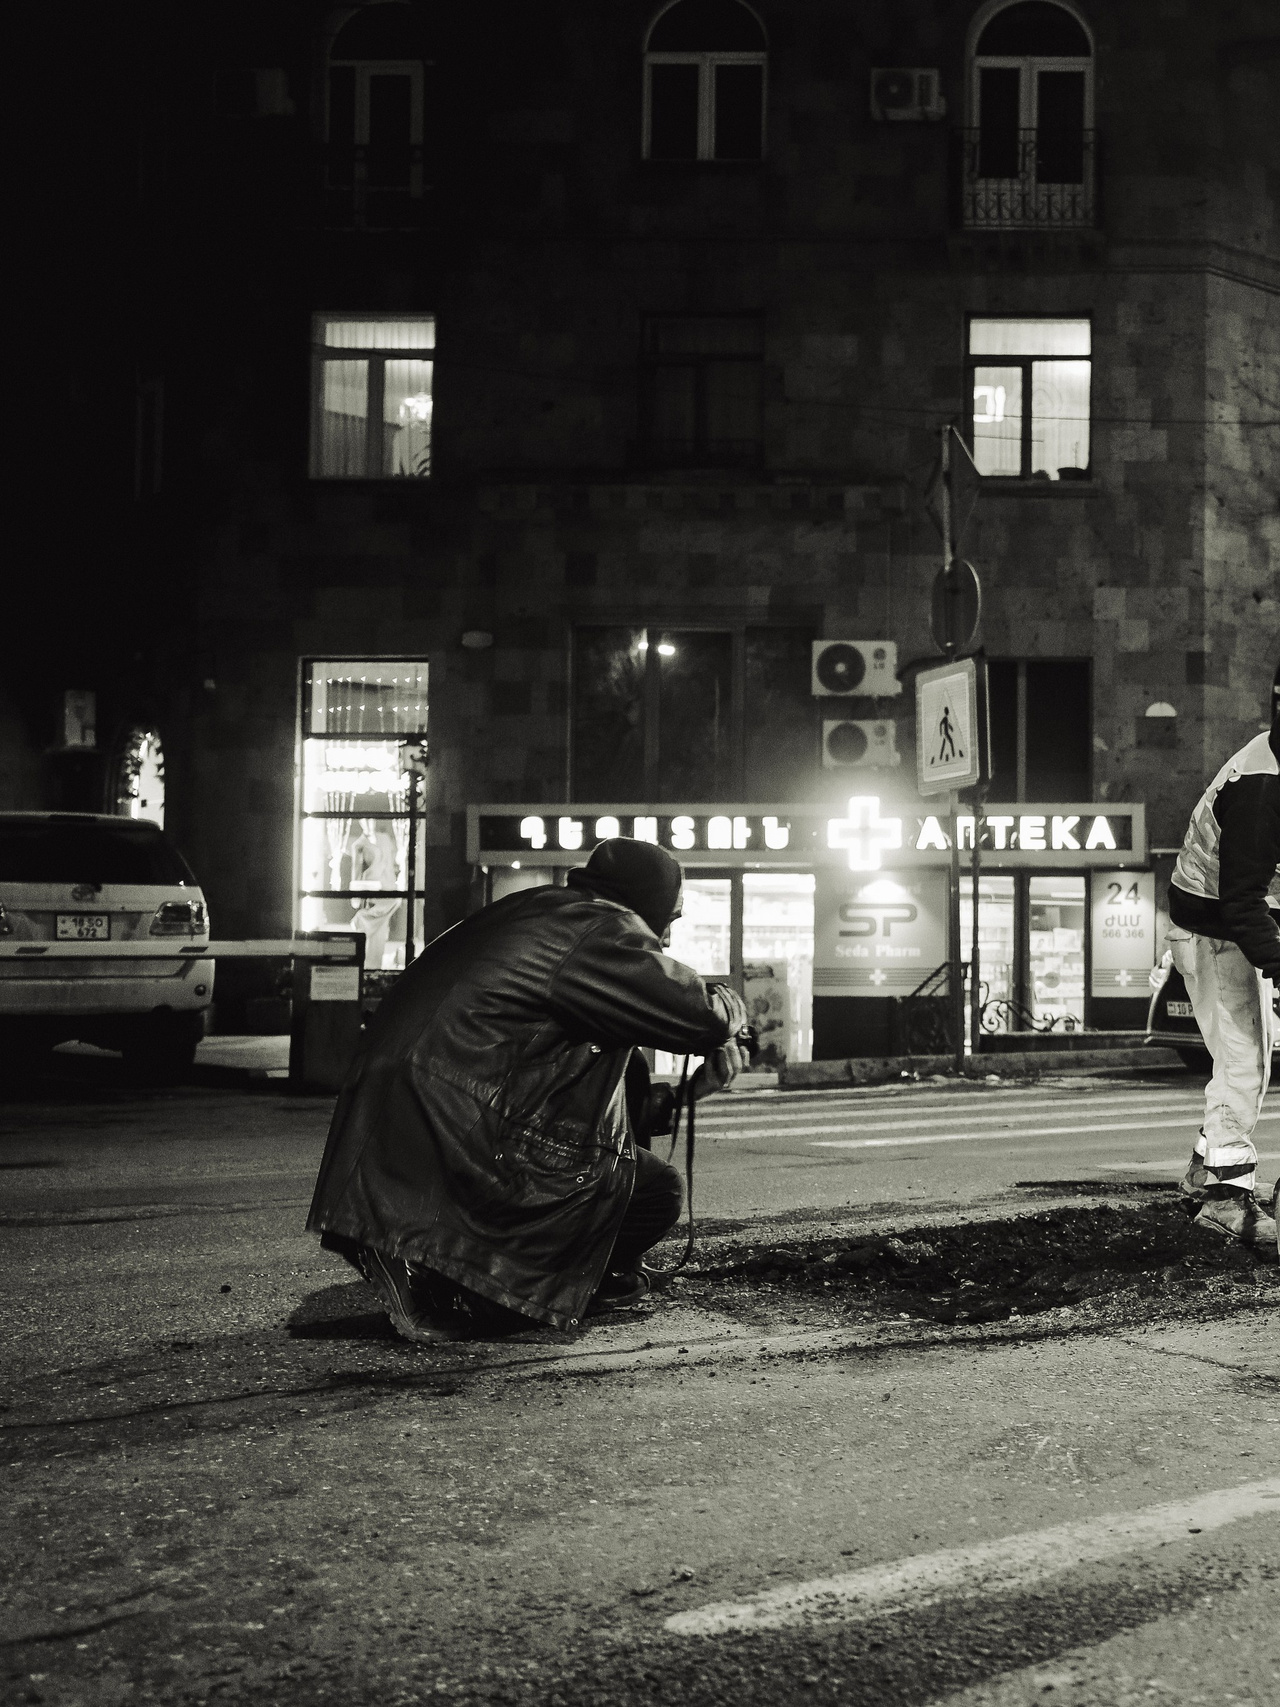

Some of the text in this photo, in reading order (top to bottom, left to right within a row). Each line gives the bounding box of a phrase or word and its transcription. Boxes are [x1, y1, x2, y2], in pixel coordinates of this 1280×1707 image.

[915, 816, 1117, 850] АПТЕКА
[1107, 881, 1141, 905] 24
[839, 903, 918, 937] SP
[835, 944, 920, 957] Seda Pharm
